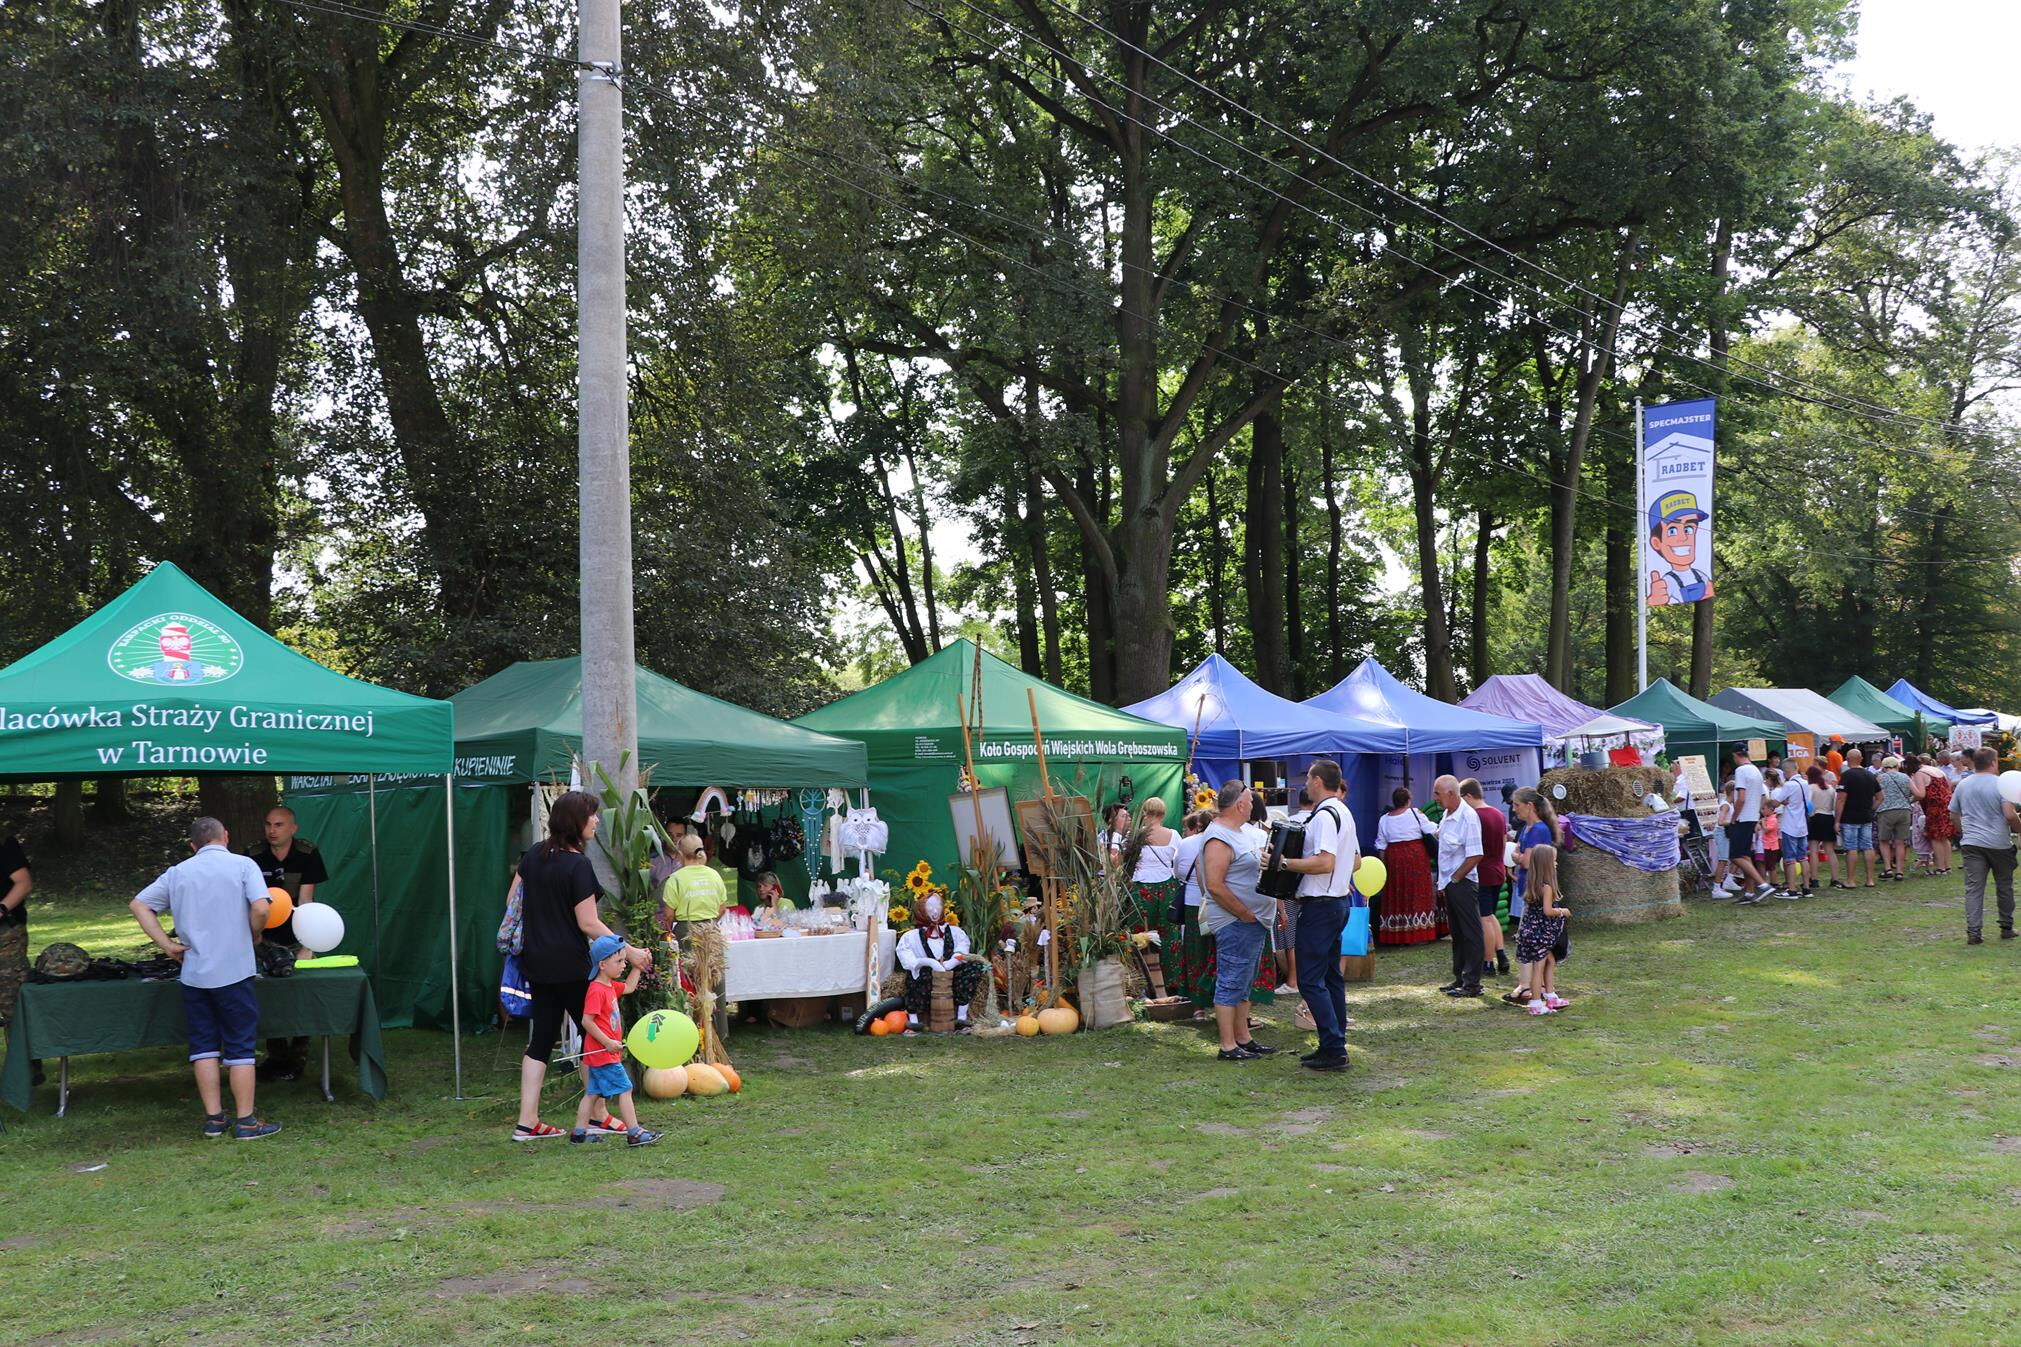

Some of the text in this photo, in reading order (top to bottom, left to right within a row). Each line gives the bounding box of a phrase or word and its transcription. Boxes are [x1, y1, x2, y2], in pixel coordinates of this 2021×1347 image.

[1649, 414, 1711, 428] SPECMAJSTER
[1661, 461, 1705, 475] RADBET
[0, 704, 374, 737] lacówka Straży Granicznej
[97, 741, 267, 764] w Tarnowie
[980, 739, 1178, 759] Koło Gospoń Wiejskich Wola Gręboszowska
[453, 755, 516, 777] KUPIENINIE
[1482, 754, 1521, 766] SOLVENT
